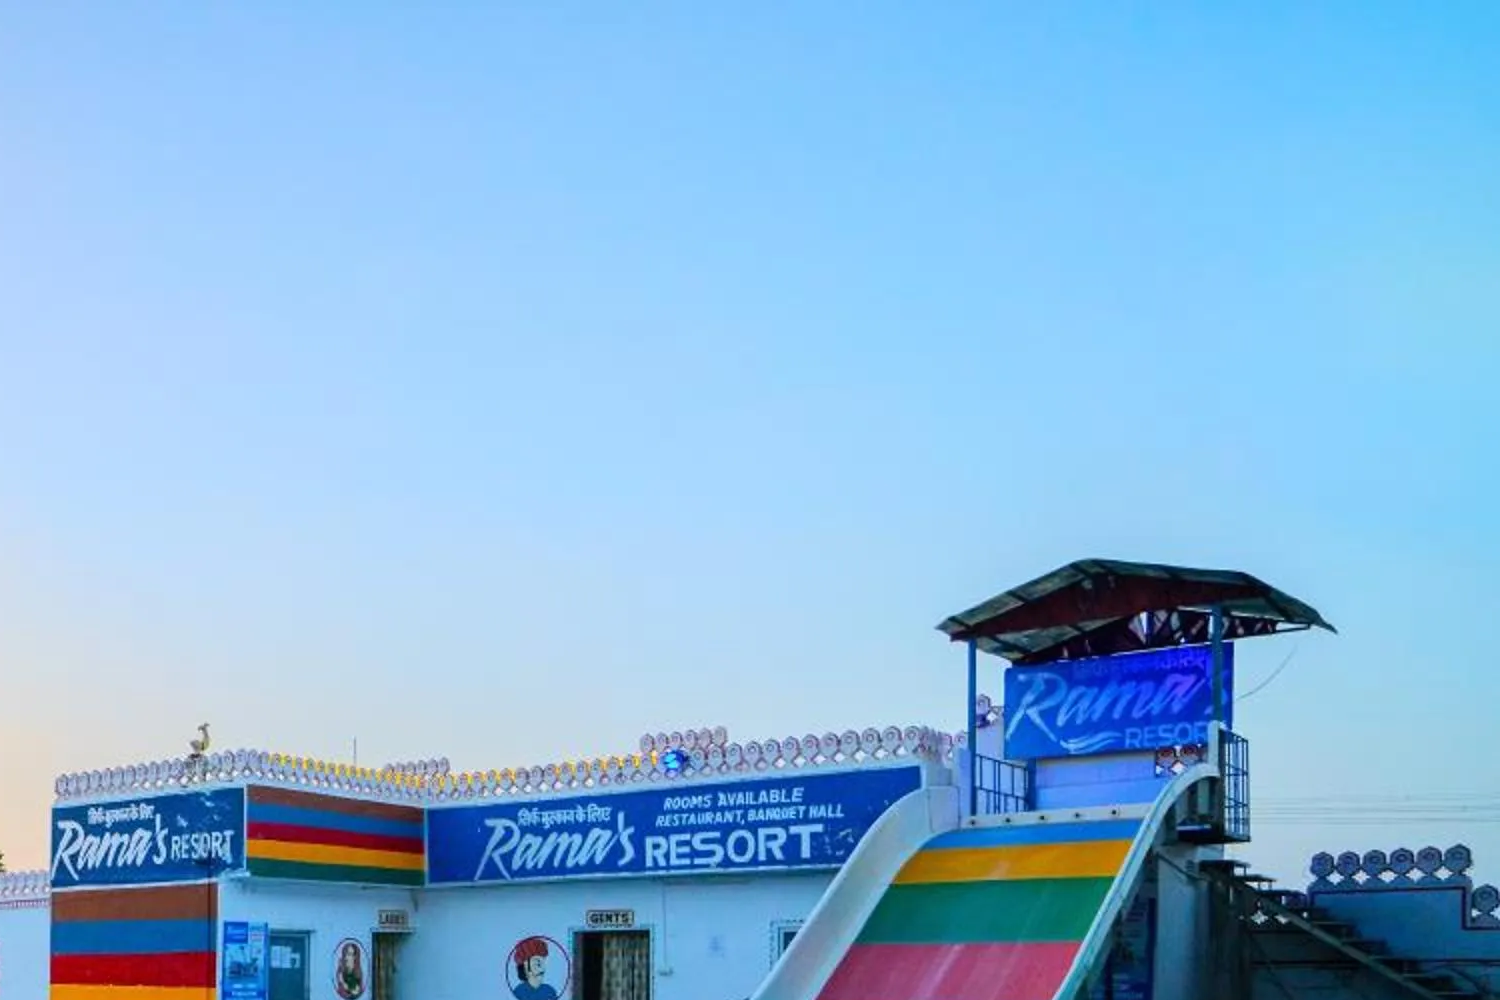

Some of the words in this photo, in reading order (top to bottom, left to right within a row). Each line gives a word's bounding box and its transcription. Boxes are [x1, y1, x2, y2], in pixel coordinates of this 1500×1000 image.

[1124, 721, 1208, 748] RESOR
[663, 794, 712, 811] ROOMS
[717, 787, 805, 807] AVAILABLE
[655, 809, 745, 827] RESTAURANT,
[747, 805, 806, 822] BANQUET
[809, 803, 845, 818] HALL
[51, 813, 169, 881] Rama's
[171, 829, 235, 863] RESORT
[474, 811, 636, 881] Rama's
[645, 823, 825, 868] RESORT
